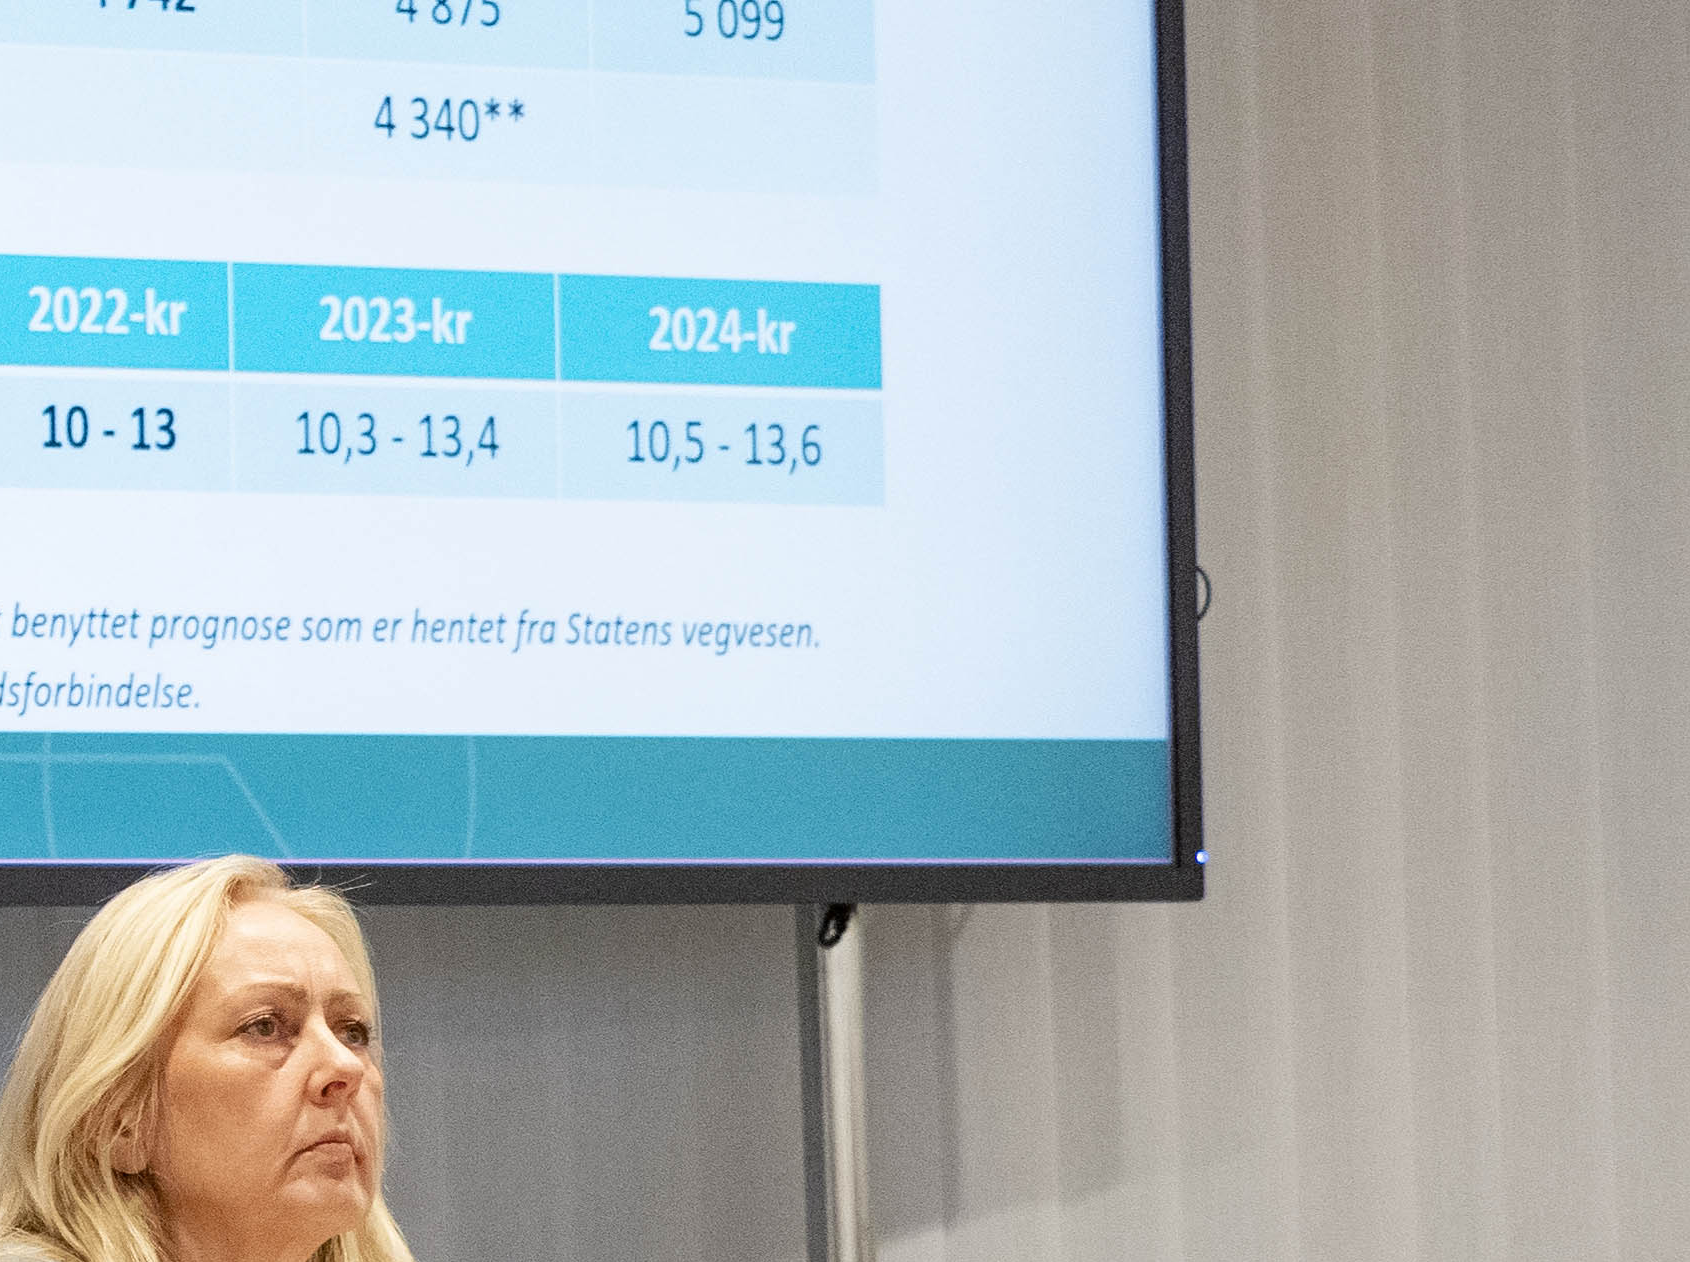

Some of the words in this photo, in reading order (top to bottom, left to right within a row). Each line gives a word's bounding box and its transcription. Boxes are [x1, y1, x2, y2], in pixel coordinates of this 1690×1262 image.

[685, 0, 704, 37] 5
[717, 0, 785, 41] 099
[374, 96, 397, 138] 4
[27, 286, 188, 337] 2022-kr
[318, 295, 474, 345] 2023-kr
[648, 305, 797, 355] 2024-kr
[42, 404, 89, 449] 10
[131, 407, 177, 451] 13
[297, 411, 377, 464] 10,3
[419, 414, 500, 467] 13,4
[628, 420, 704, 472] 10,5
[745, 423, 823, 474] 13,6
[11, 602, 141, 648] benyttet
[149, 615, 291, 651] prognose
[301, 617, 362, 643] som
[372, 617, 404, 643] er
[412, 608, 507, 645] hentet
[511, 609, 557, 653] fra
[565, 613, 672, 647] Statens
[682, 621, 821, 656] vegvesen.
